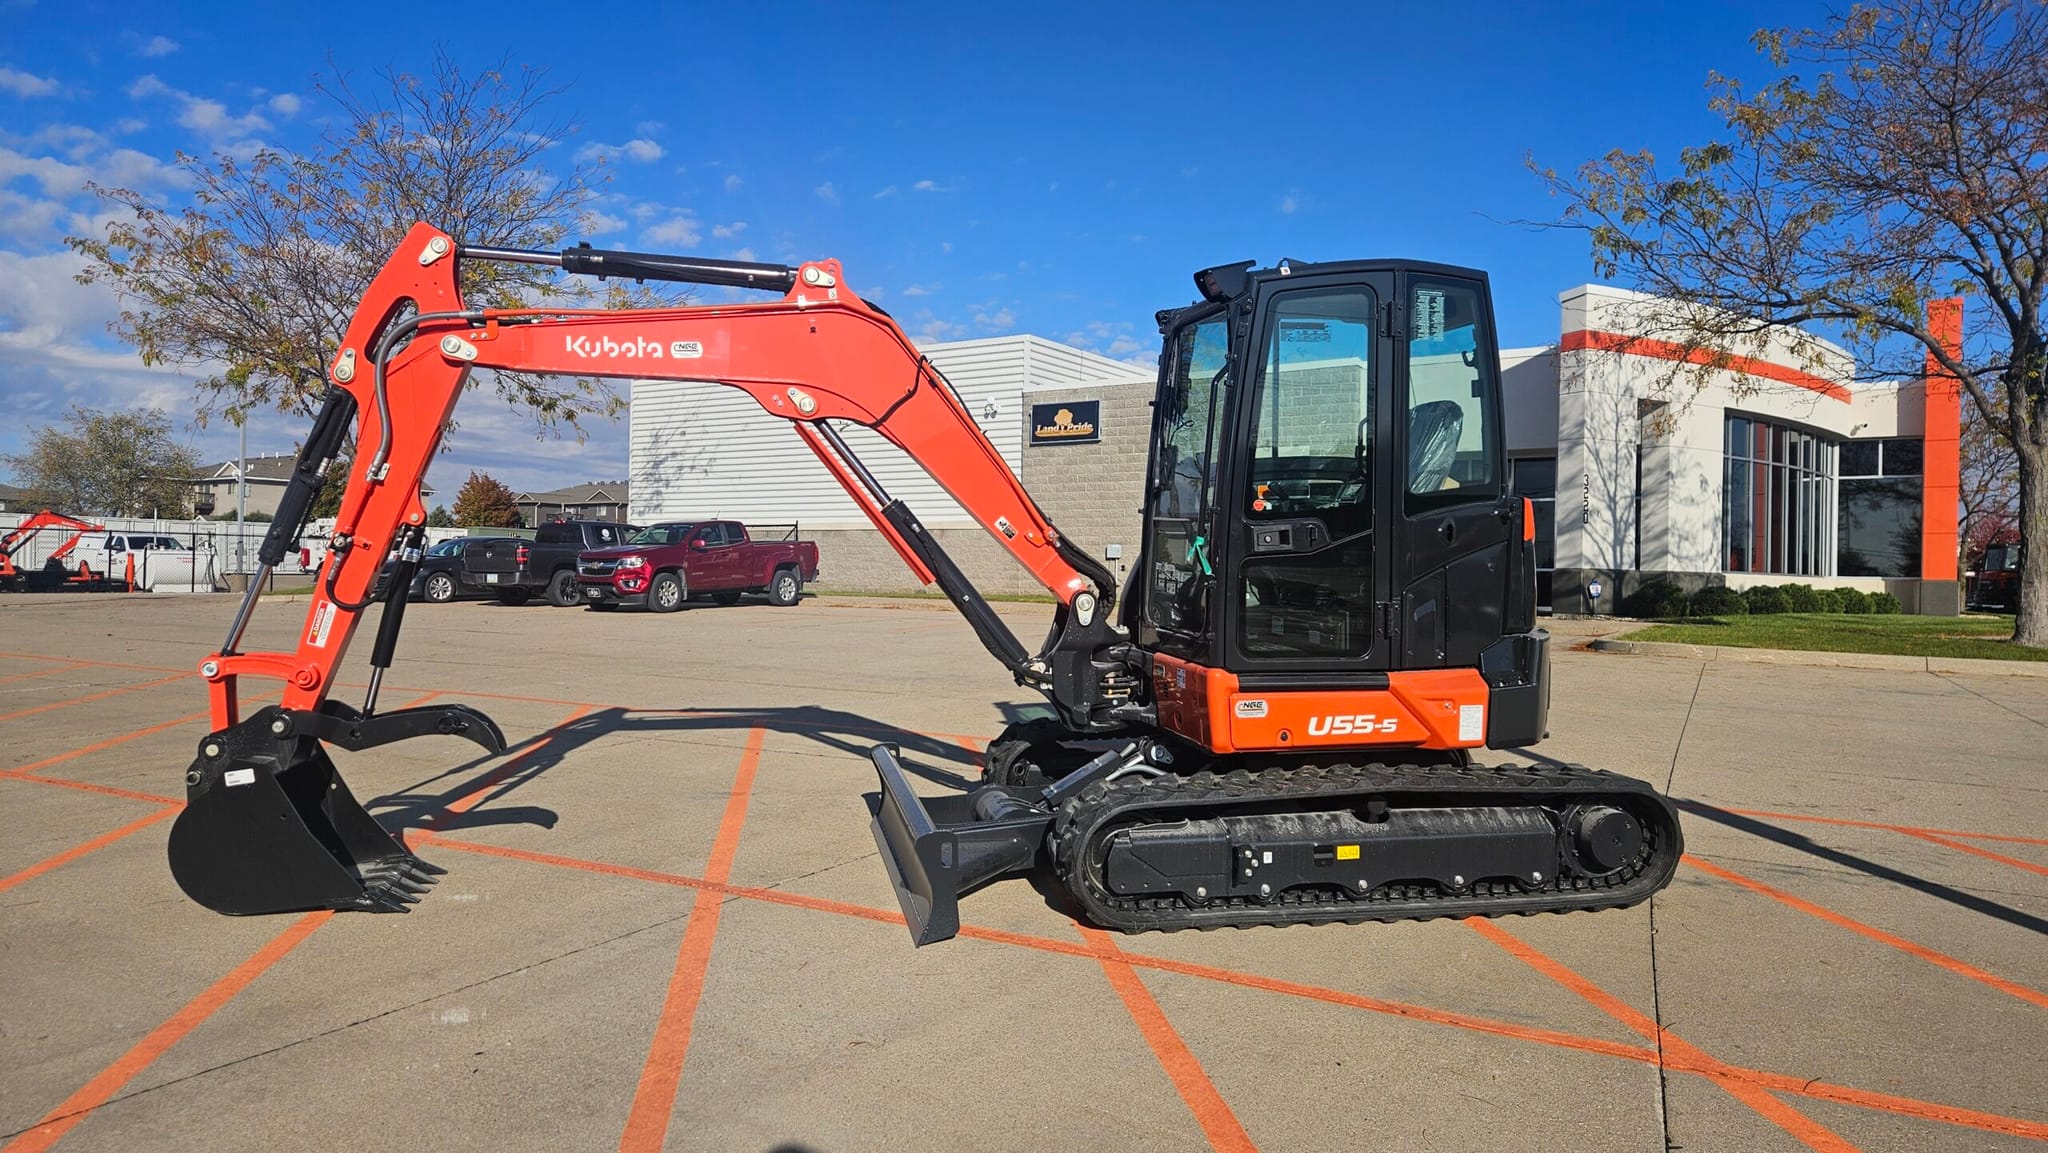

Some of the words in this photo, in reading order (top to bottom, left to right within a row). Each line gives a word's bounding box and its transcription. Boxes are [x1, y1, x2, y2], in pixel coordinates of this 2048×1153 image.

[566, 336, 663, 357] Kubota
[1037, 424, 1059, 432] Land
[1067, 422, 1093, 431] Pride
